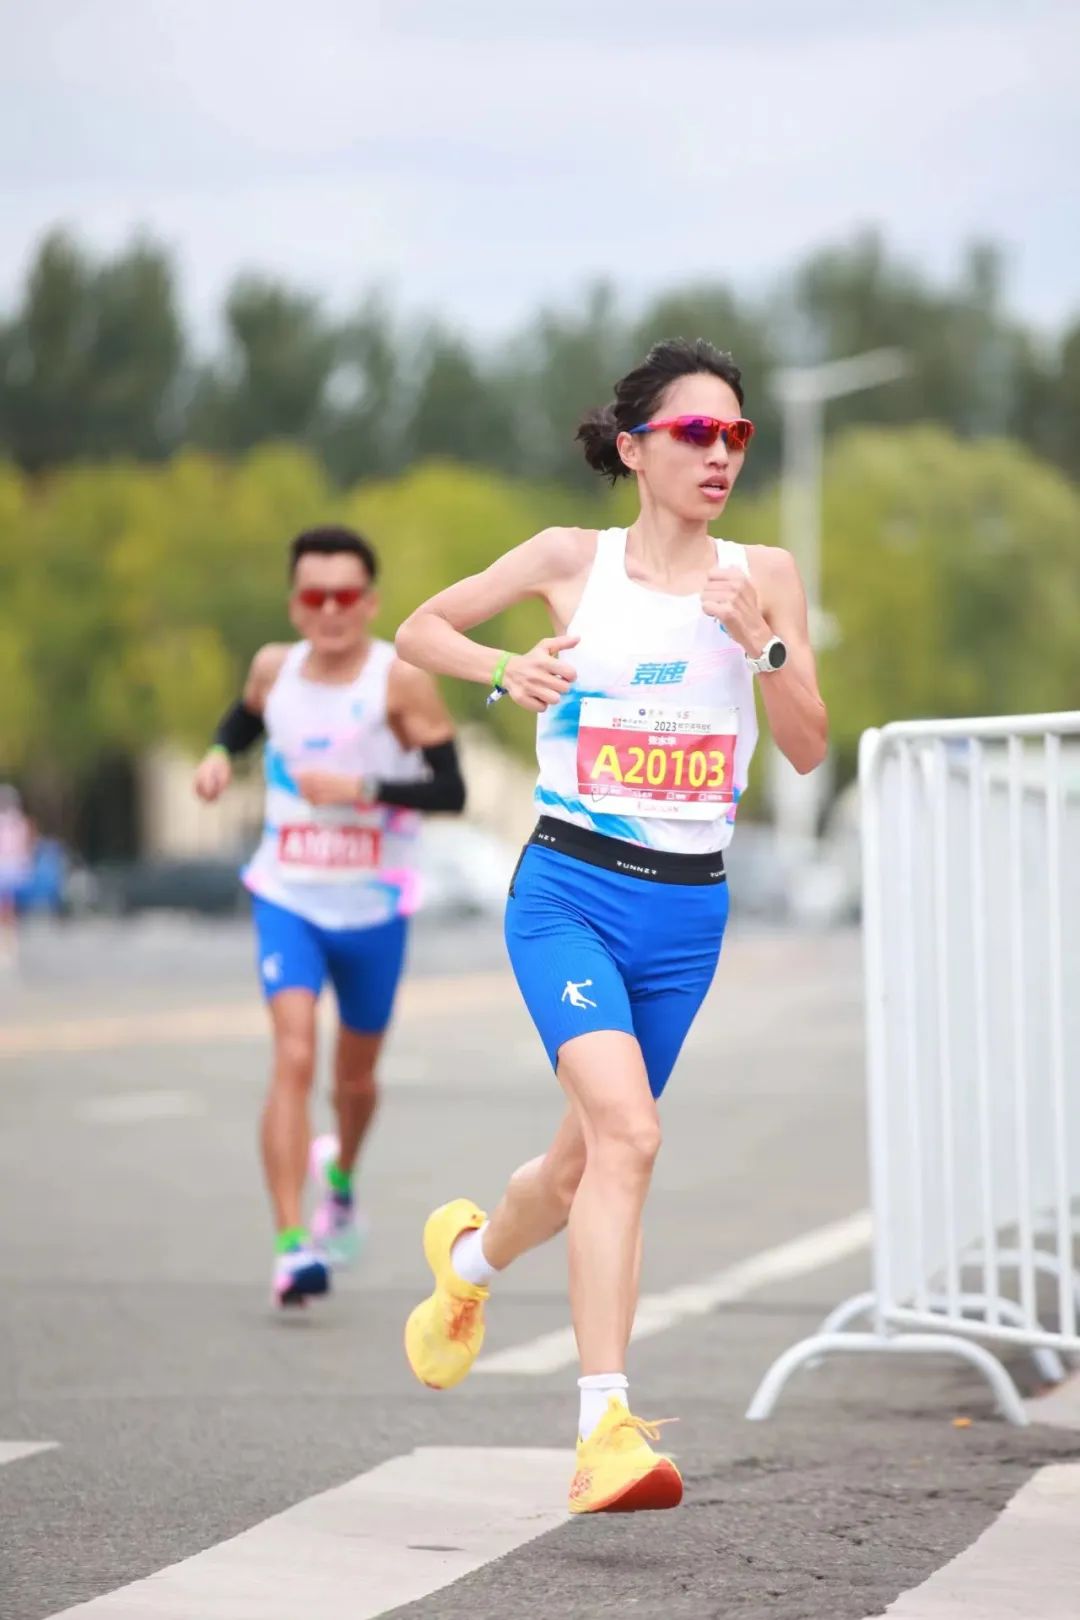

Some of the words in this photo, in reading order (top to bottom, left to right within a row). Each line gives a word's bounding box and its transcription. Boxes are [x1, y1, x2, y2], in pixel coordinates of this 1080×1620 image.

[630, 660, 689, 685] 竞速
[654, 721, 677, 732] 2023
[590, 744, 726, 788] A20103
